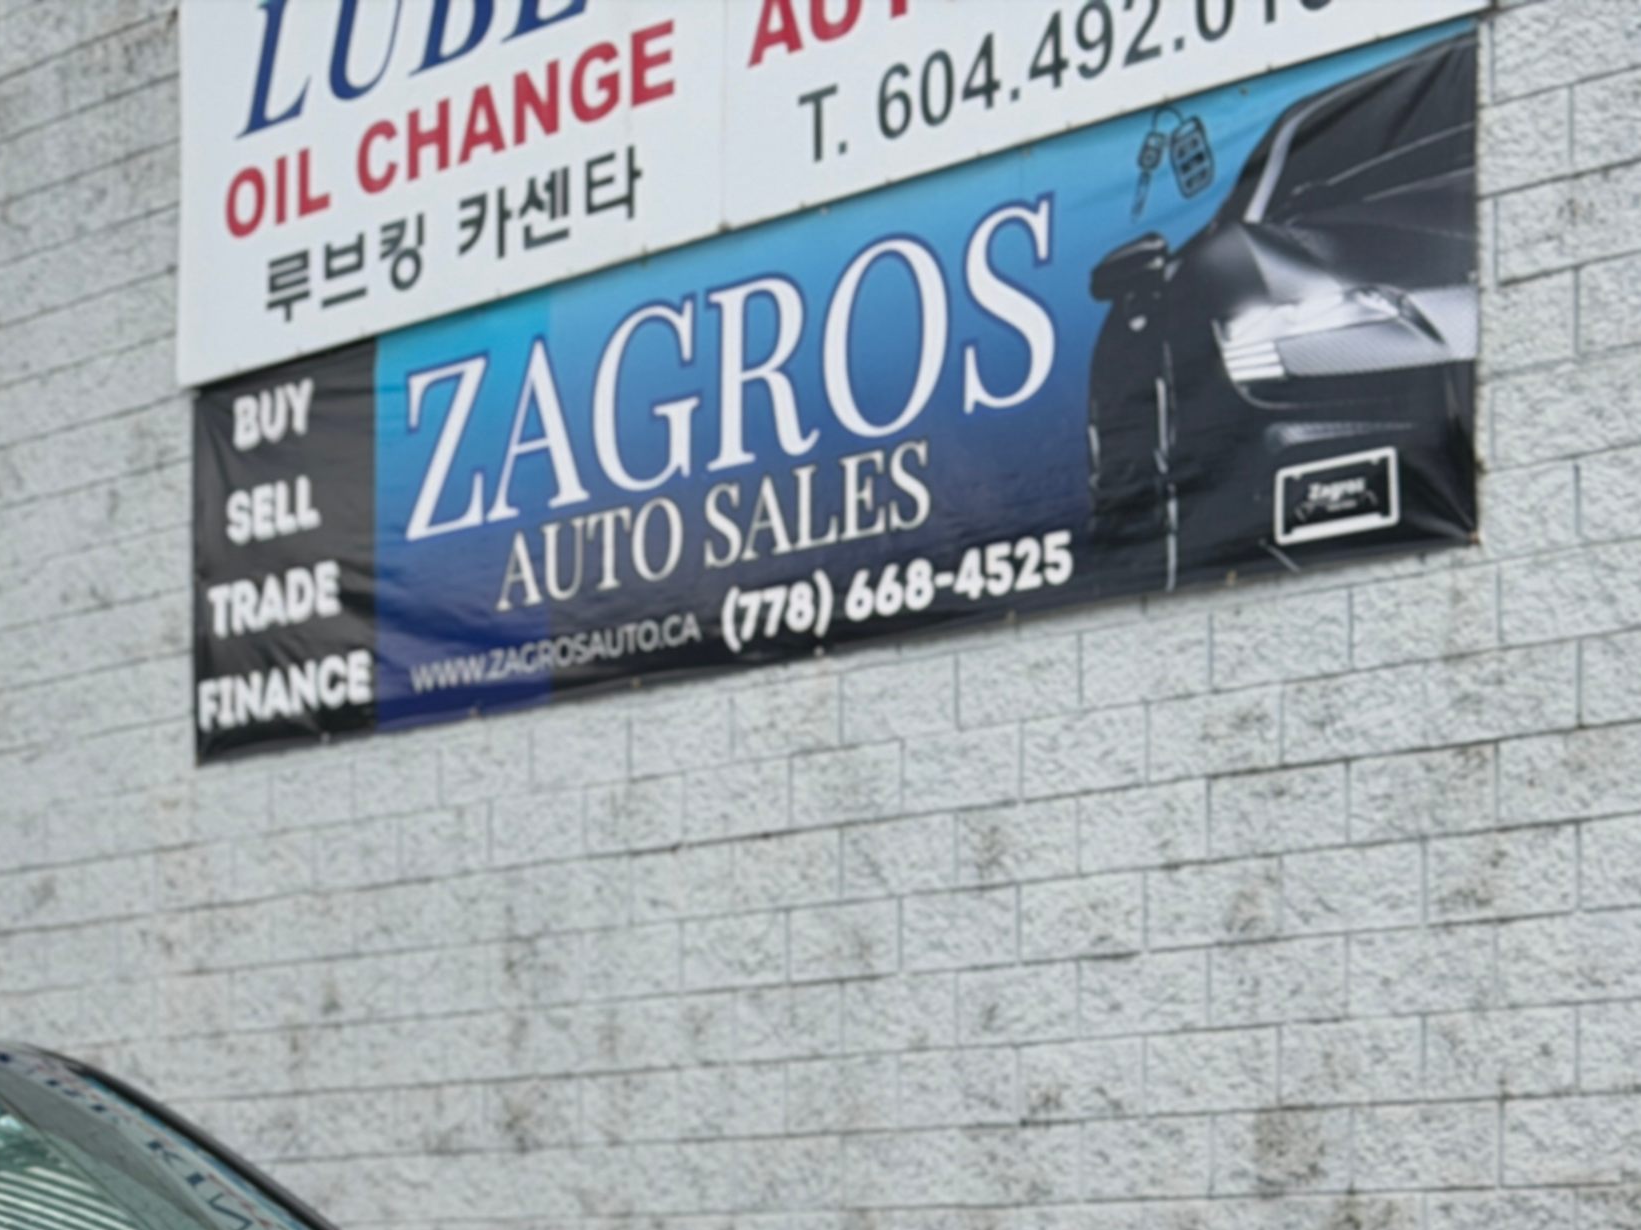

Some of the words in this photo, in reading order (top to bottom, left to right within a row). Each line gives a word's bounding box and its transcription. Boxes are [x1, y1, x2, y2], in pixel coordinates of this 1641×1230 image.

[224, 147, 331, 239] OIL
[356, 20, 676, 195] CHANGE
[797, 83, 848, 163] T.
[265, 212, 427, 323] 루브킹
[458, 145, 643, 259] 카센타
[404, 192, 1056, 542] ZAGROS
[232, 378, 315, 451] BUY
[225, 475, 321, 544] SELL
[496, 497, 685, 613] AUTO
[703, 439, 933, 570] SALES
[207, 561, 341, 639] TRADE
[721, 568, 834, 652] (778)
[844, 530, 1075, 622] 668-4525
[197, 650, 372, 732] FINANCE
[409, 611, 702, 694] WWW.ZAGROSAUTO.CA
